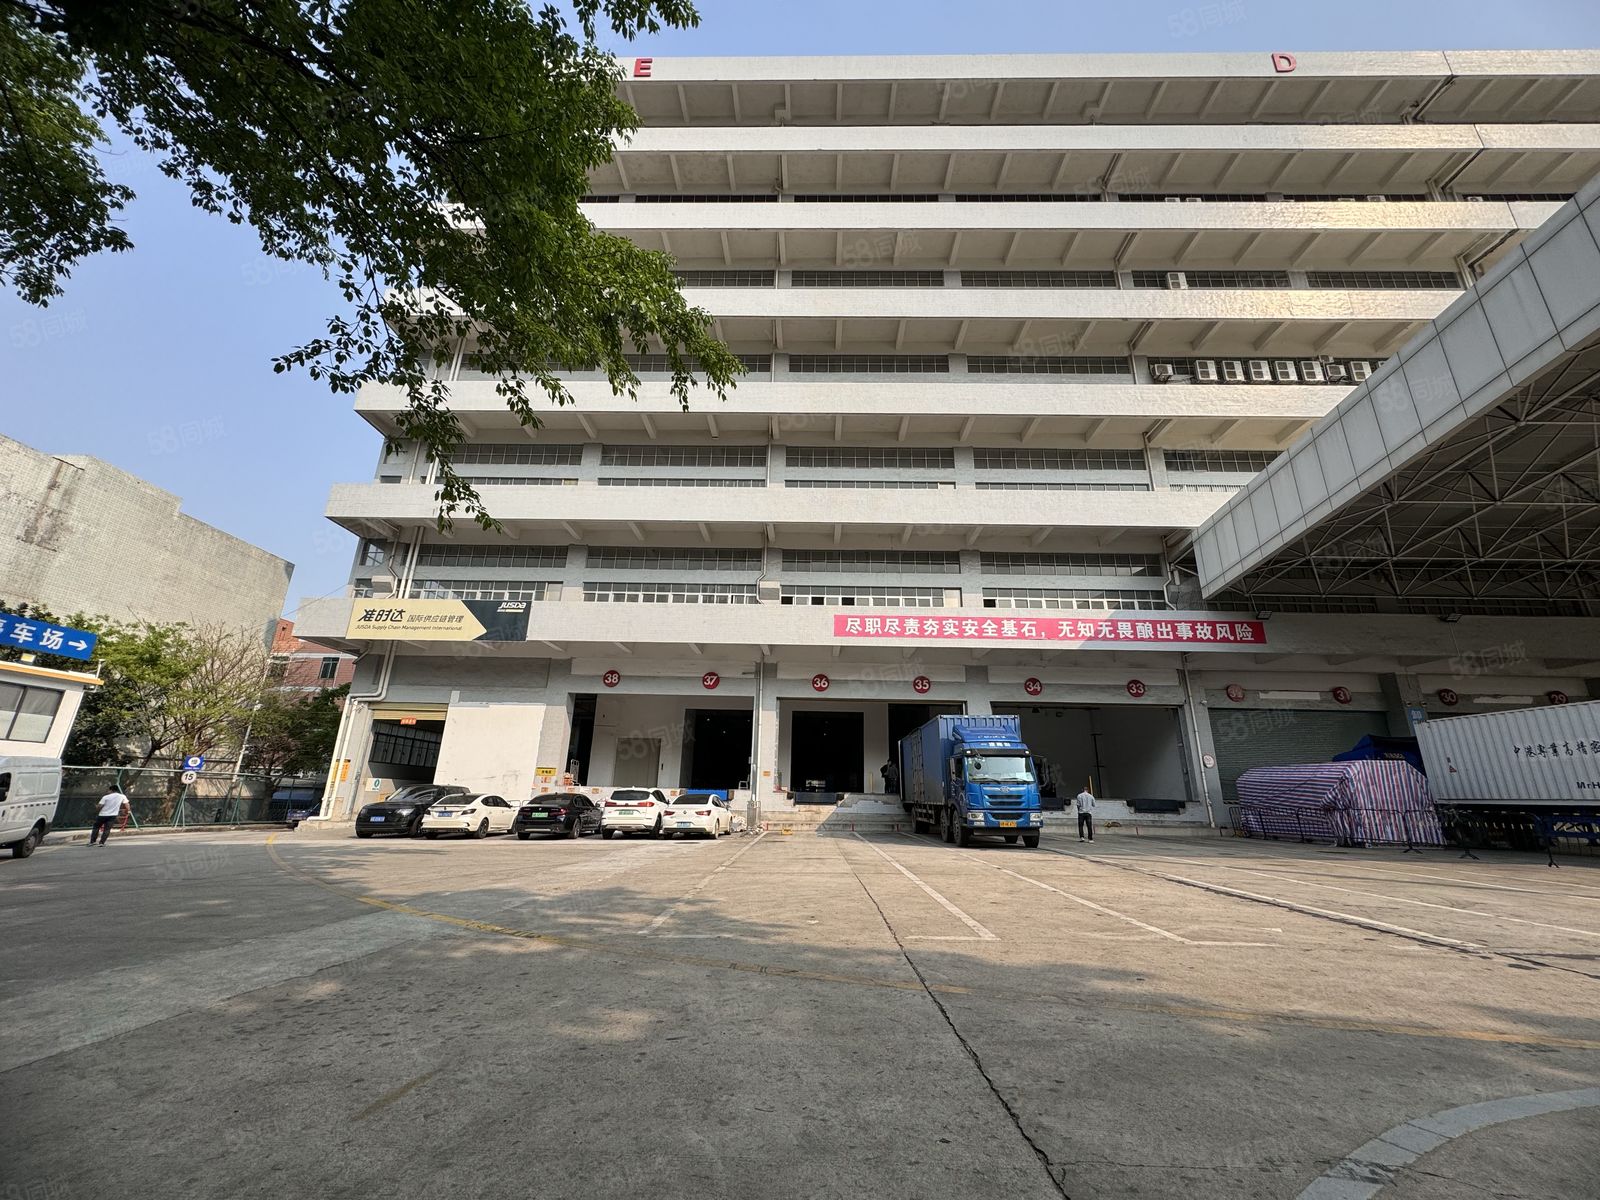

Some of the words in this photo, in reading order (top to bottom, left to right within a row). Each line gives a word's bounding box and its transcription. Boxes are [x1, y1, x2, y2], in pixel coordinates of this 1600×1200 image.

[634, 58, 652, 77] E
[1271, 53, 1296, 73] D
[358, 609, 406, 622] 准时达
[407, 614, 464, 623] 国际供应链管理
[604, 673, 619, 683] 38
[704, 675, 717, 685] 37
[813, 678, 828, 688] 36
[915, 679, 929, 690] 35
[1026, 681, 1041, 692] 34
[1129, 683, 1144, 693] 33
[1440, 692, 1456, 703] 30
[1551, 694, 1566, 704] 29
